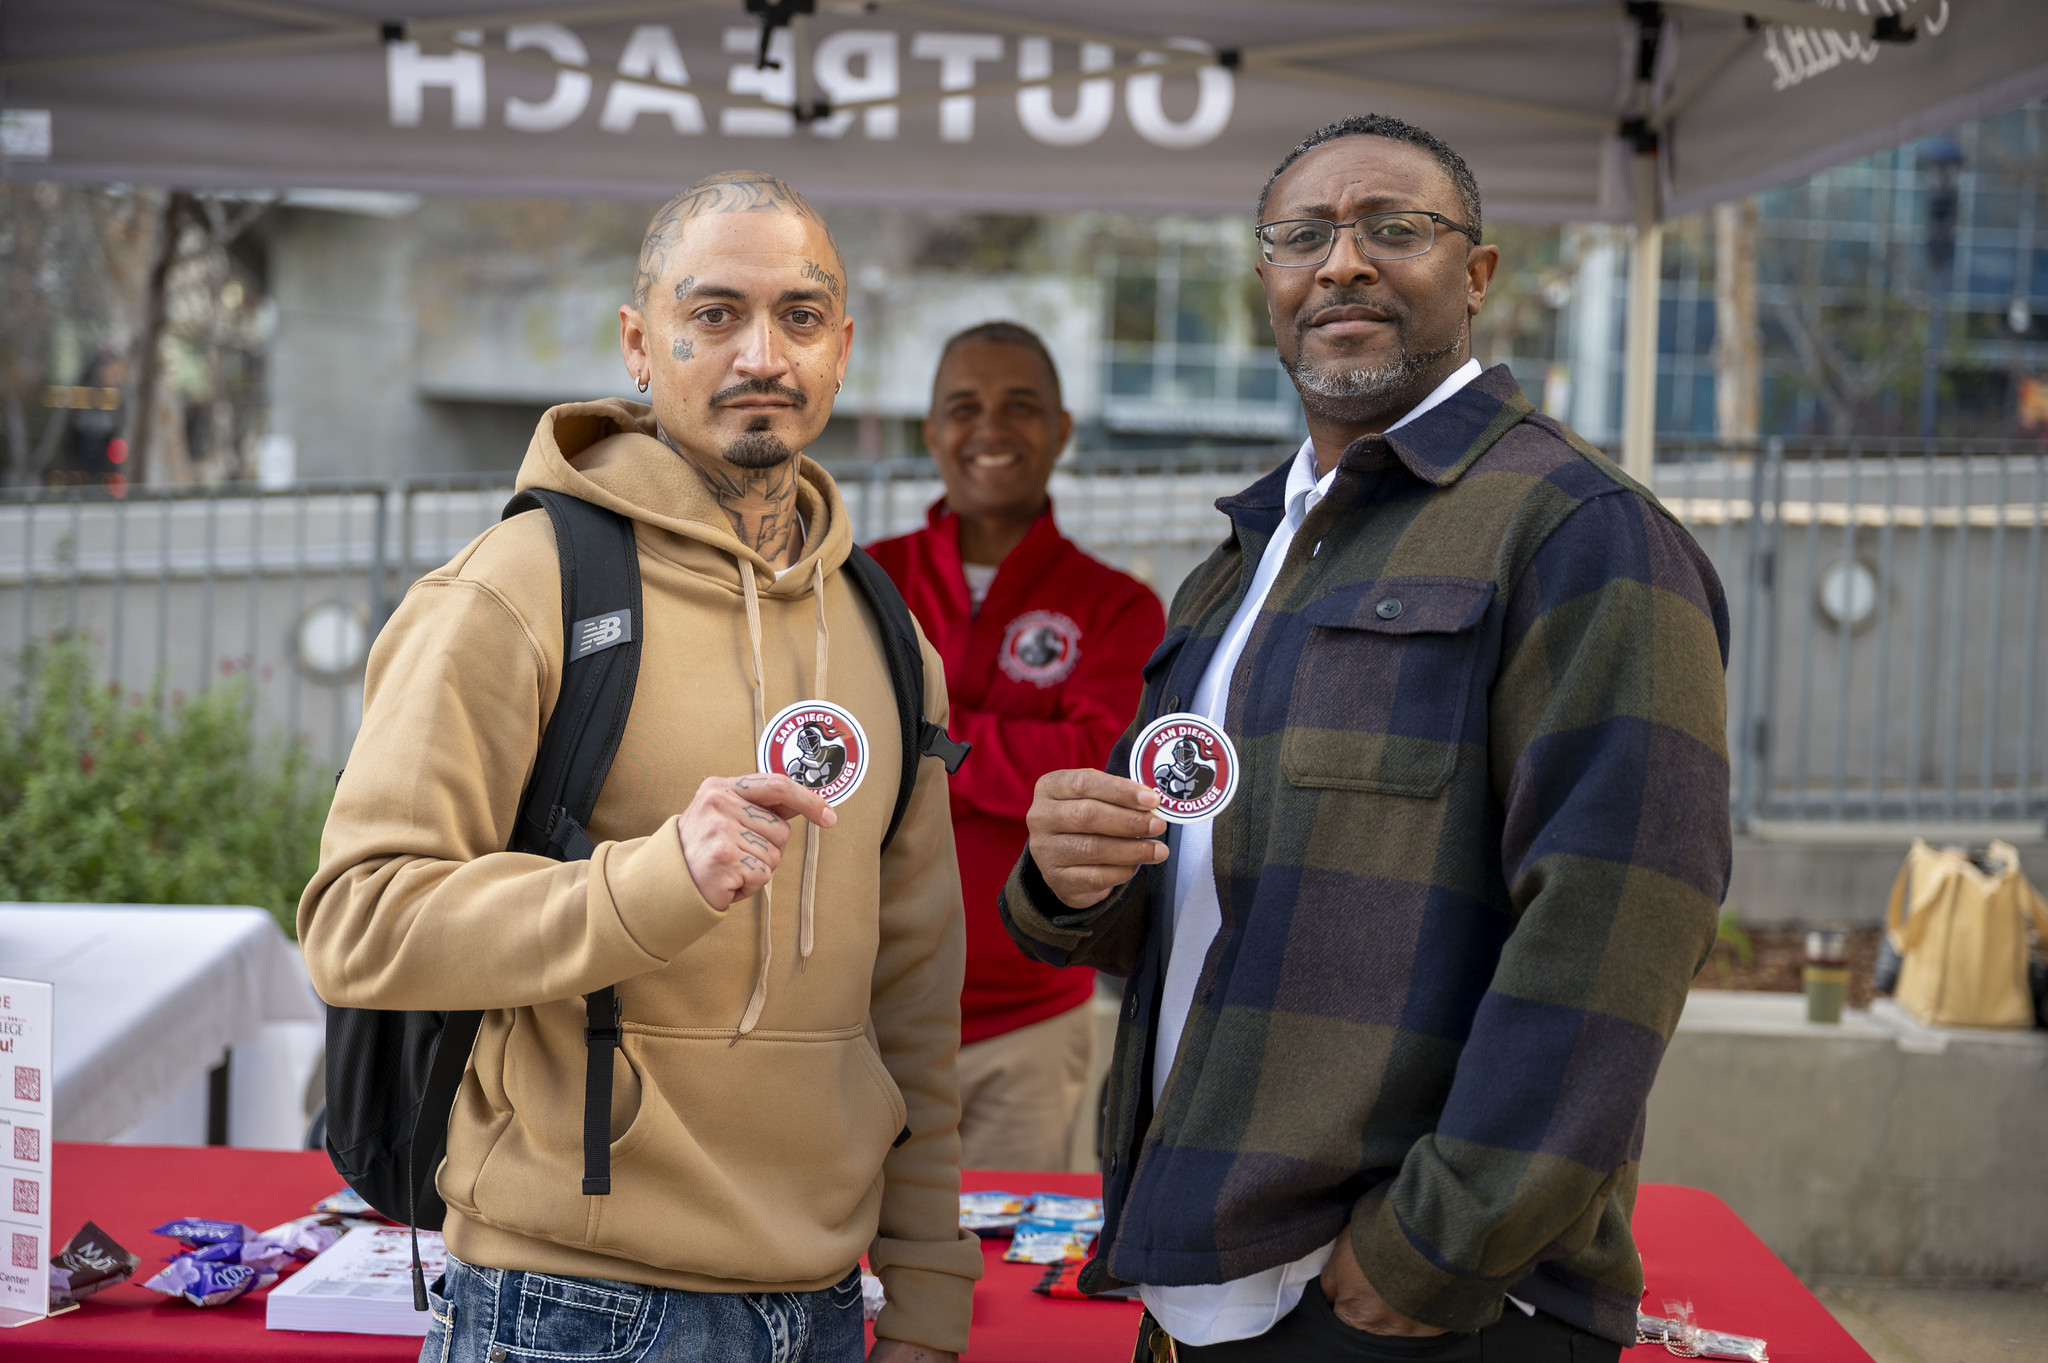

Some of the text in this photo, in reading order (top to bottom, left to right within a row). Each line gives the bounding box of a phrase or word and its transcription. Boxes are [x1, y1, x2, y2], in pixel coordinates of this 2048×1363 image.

[776, 713, 833, 744] SAN DIEGO
[1154, 727, 1214, 746] SAN DIEGO
[819, 760, 856, 798] COLLEGE
[1177, 785, 1222, 812] COLLEGE
